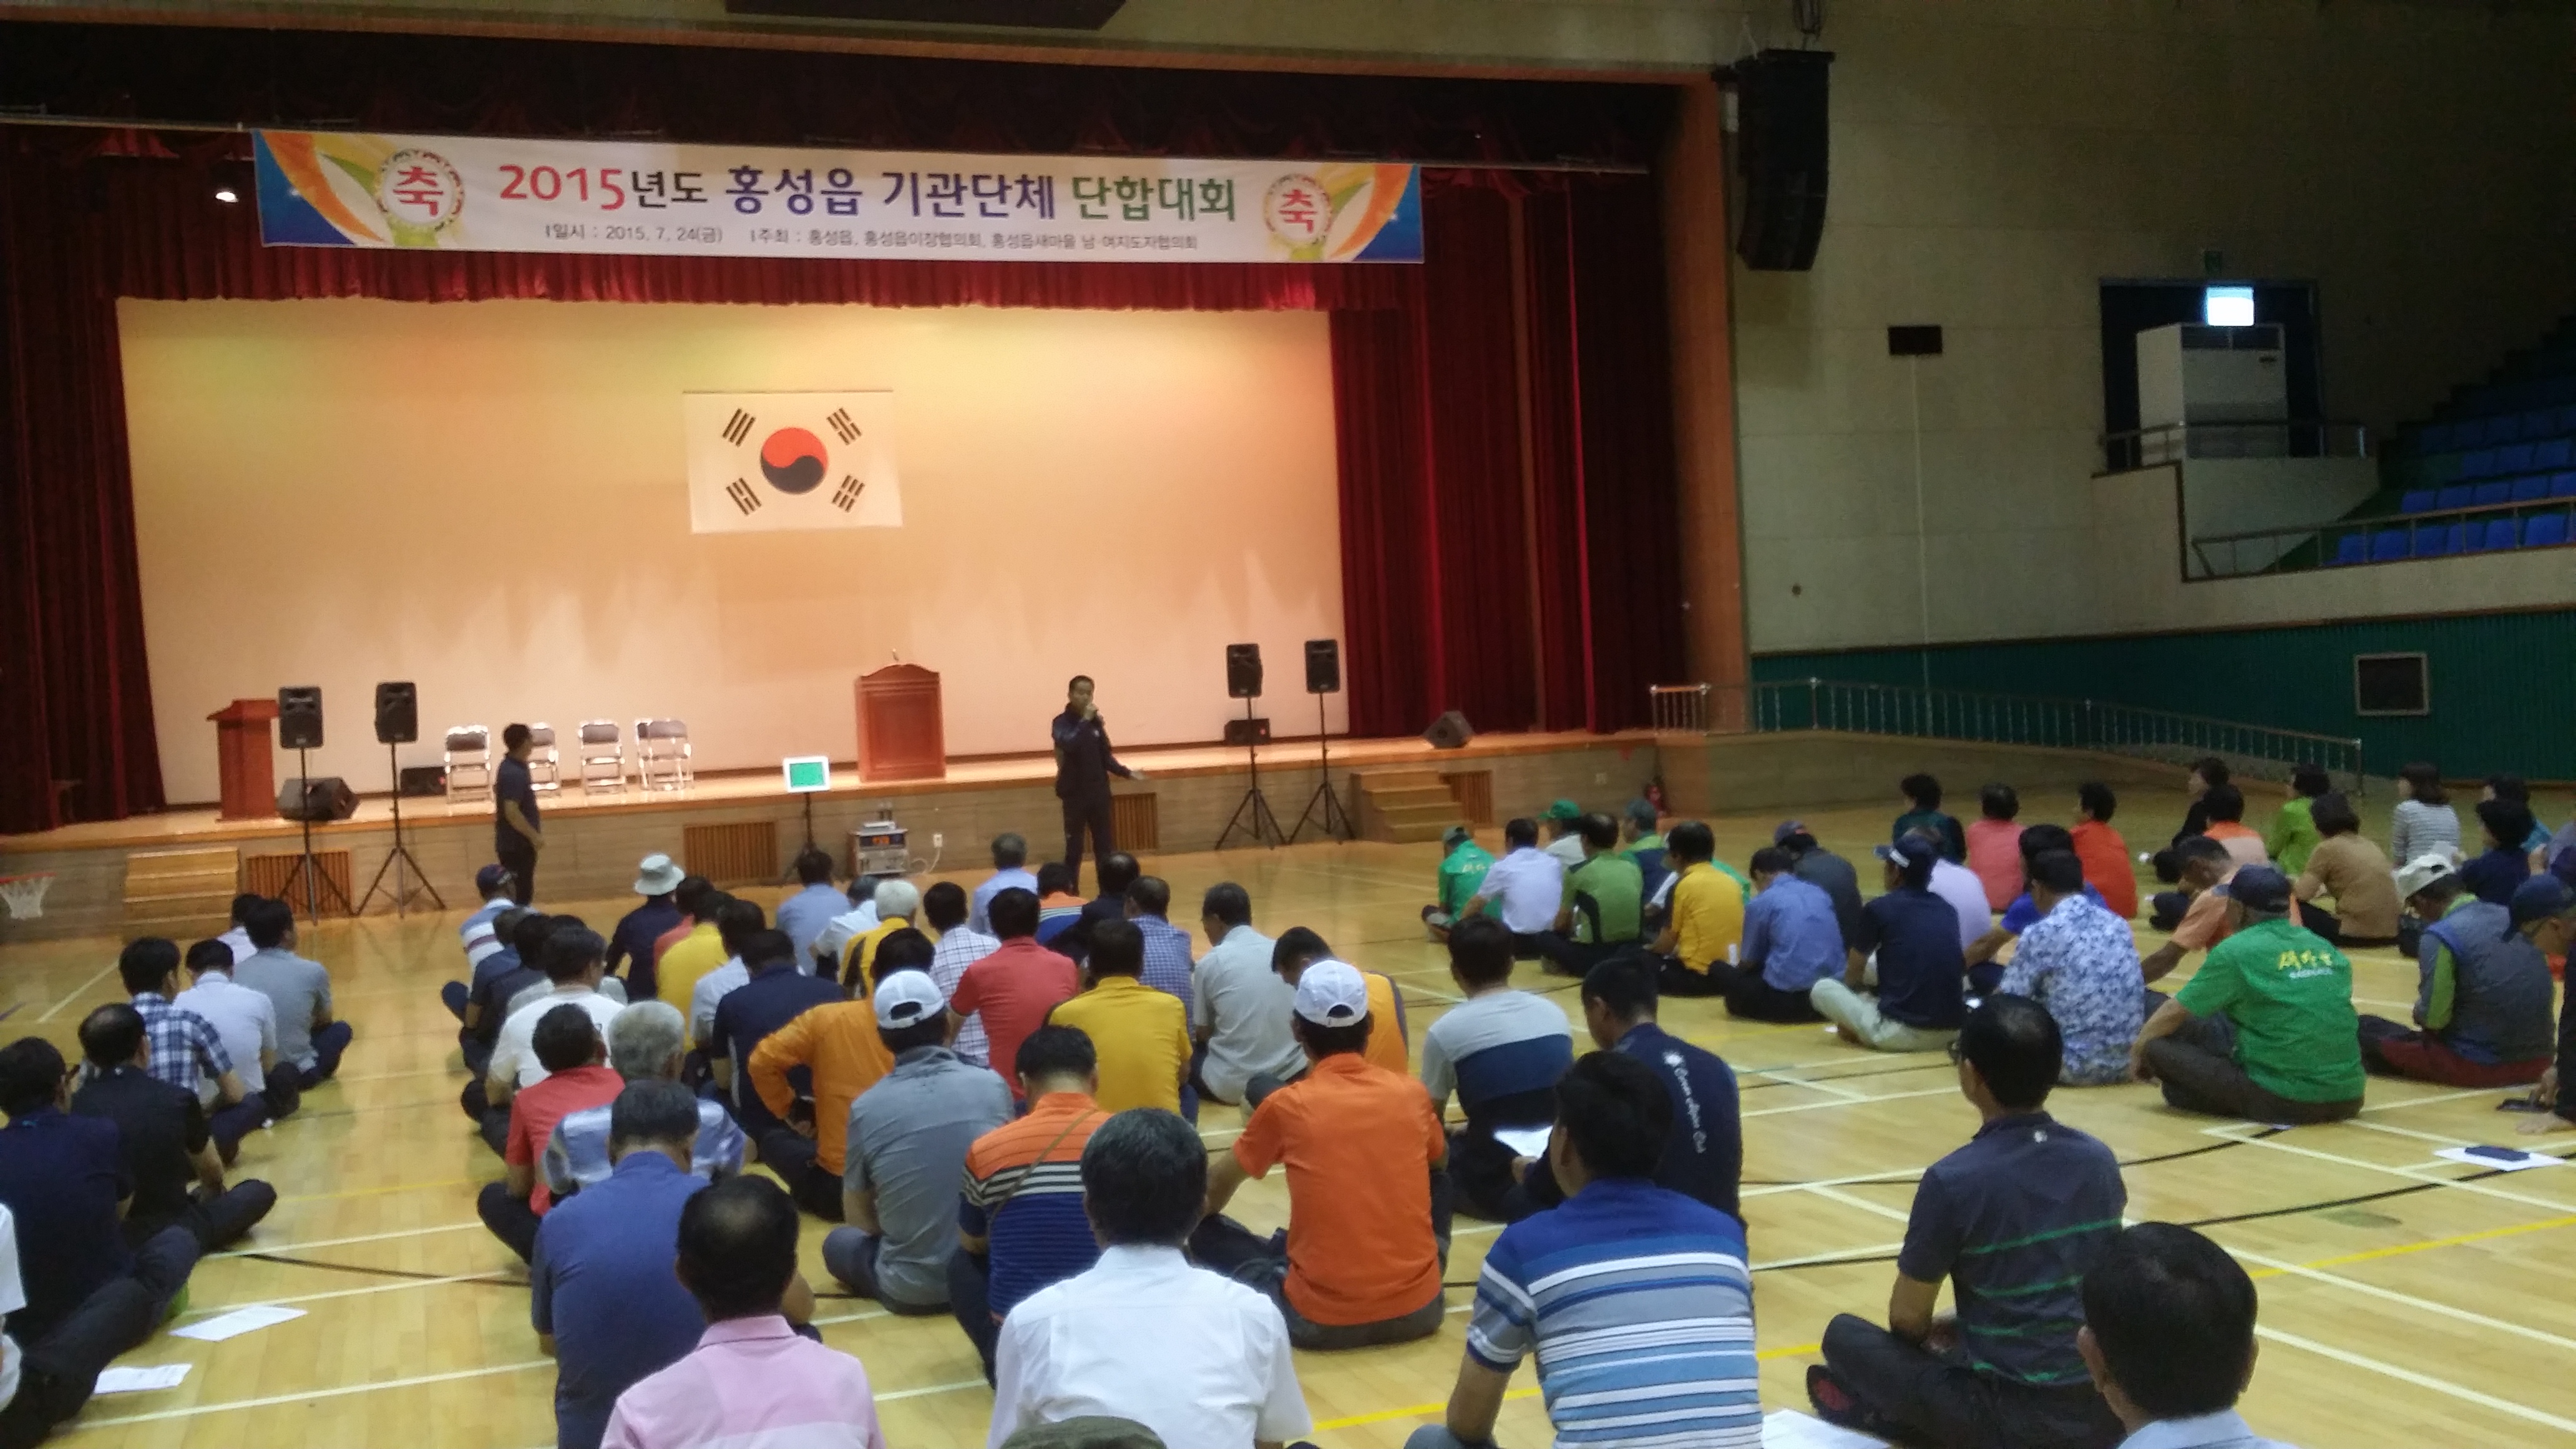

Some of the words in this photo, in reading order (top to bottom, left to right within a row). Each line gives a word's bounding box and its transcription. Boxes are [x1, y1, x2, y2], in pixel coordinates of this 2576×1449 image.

[393, 165, 444, 216] 축
[500, 164, 708, 210] 2015년도
[726, 165, 863, 215] 홍성읍
[881, 172, 1055, 219] 기관단체
[1072, 175, 1235, 221] 단합대회
[1279, 188, 1317, 233] 축
